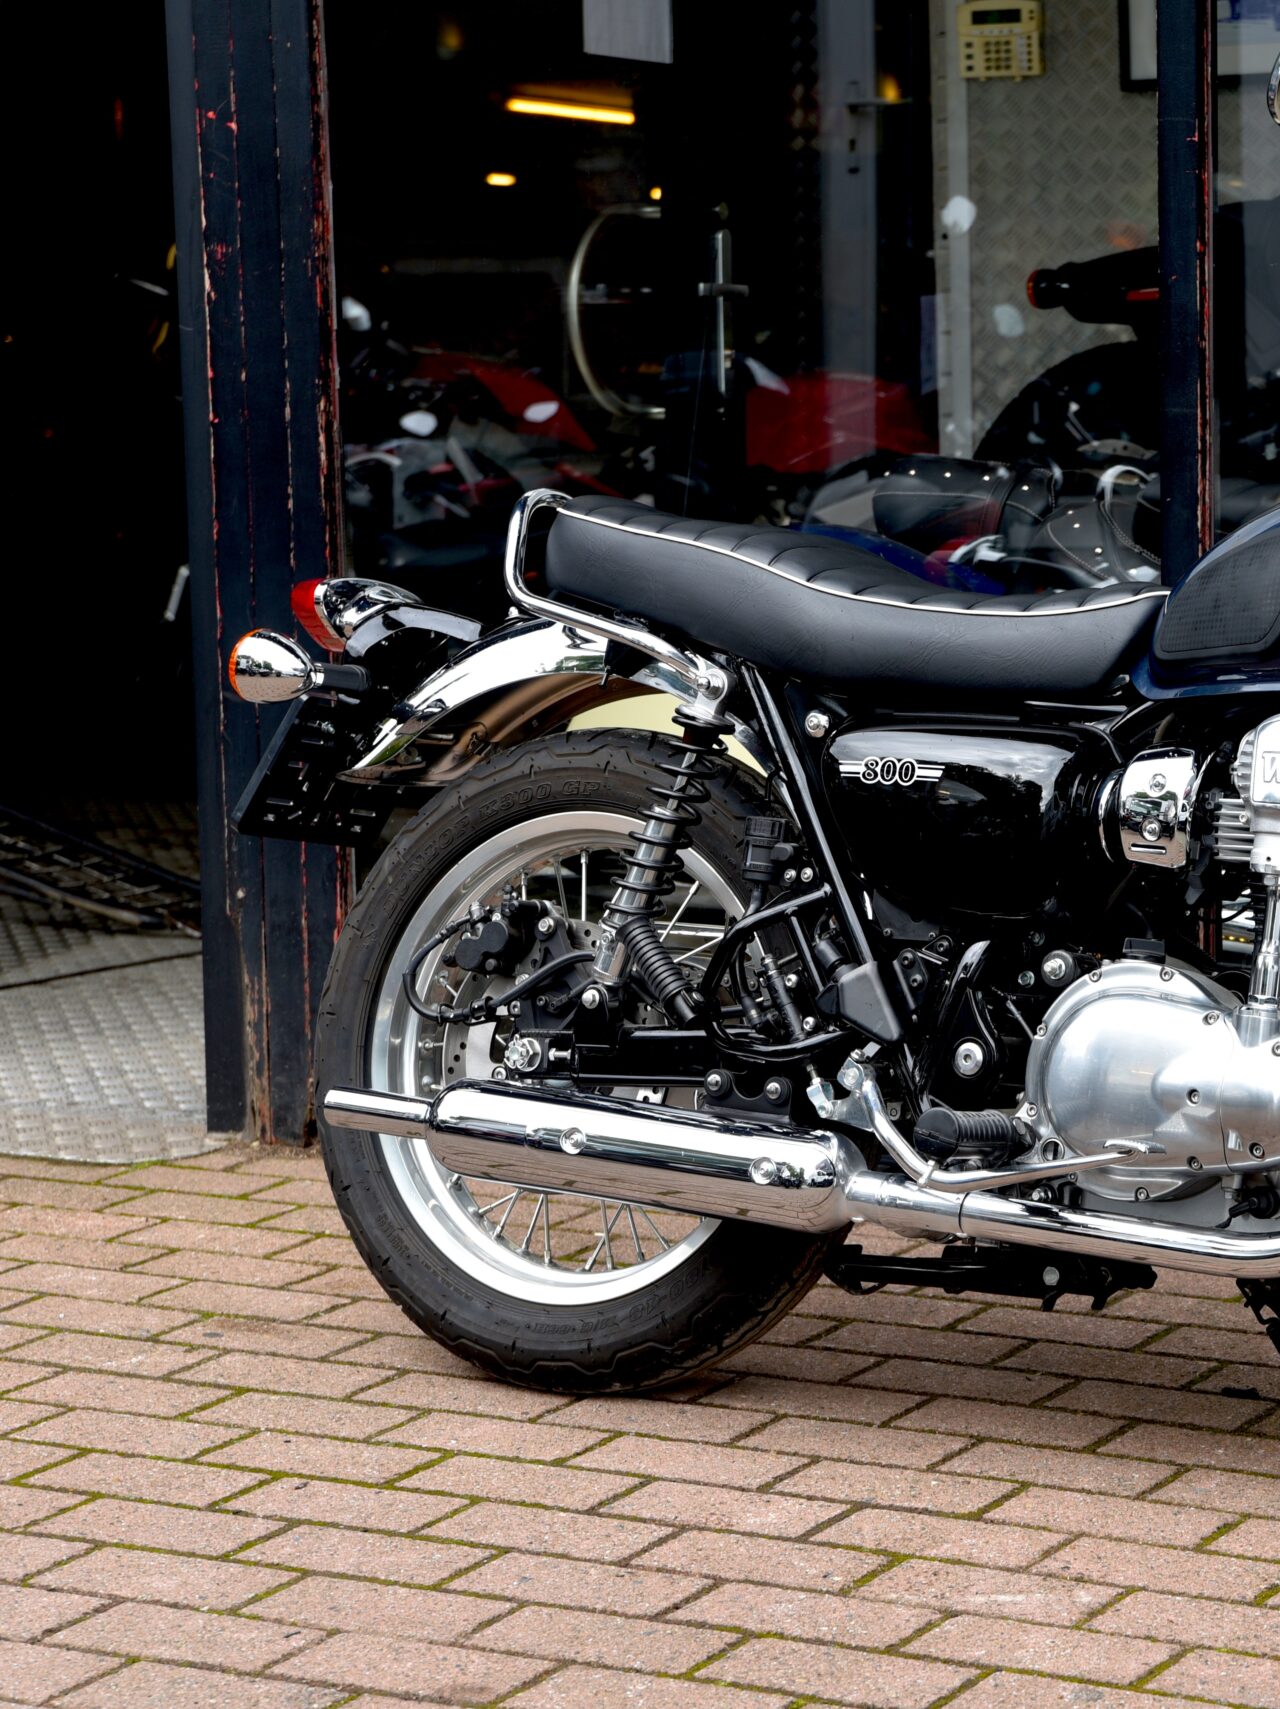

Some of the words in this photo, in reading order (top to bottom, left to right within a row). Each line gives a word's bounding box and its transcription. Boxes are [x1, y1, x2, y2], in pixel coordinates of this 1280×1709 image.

[860, 756, 917, 786] 800
[480, 783, 552, 817] K300
[561, 780, 600, 796] GP
